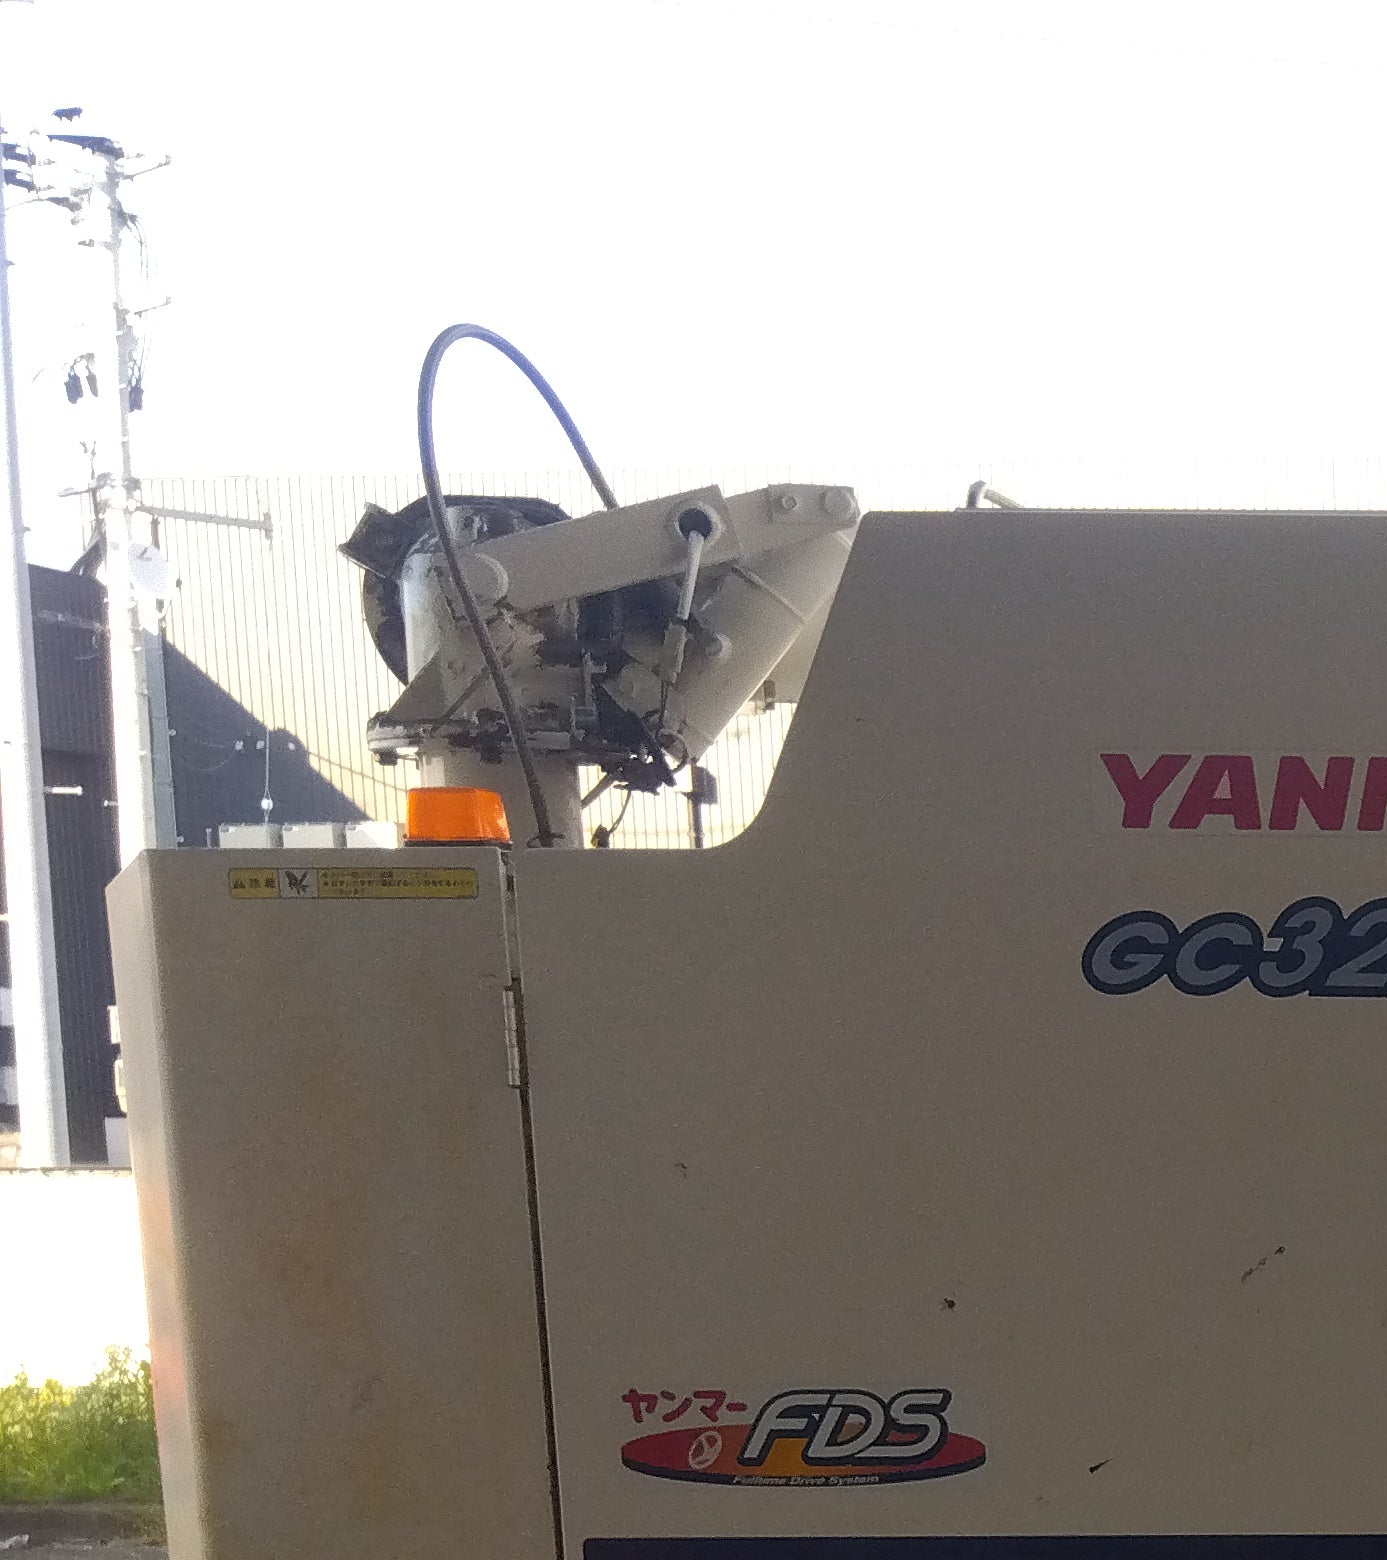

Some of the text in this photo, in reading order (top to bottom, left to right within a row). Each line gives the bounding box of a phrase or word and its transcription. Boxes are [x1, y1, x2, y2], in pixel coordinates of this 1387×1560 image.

[620, 1388, 748, 1423] ヤンマー
[737, 1388, 953, 1467] FDS
